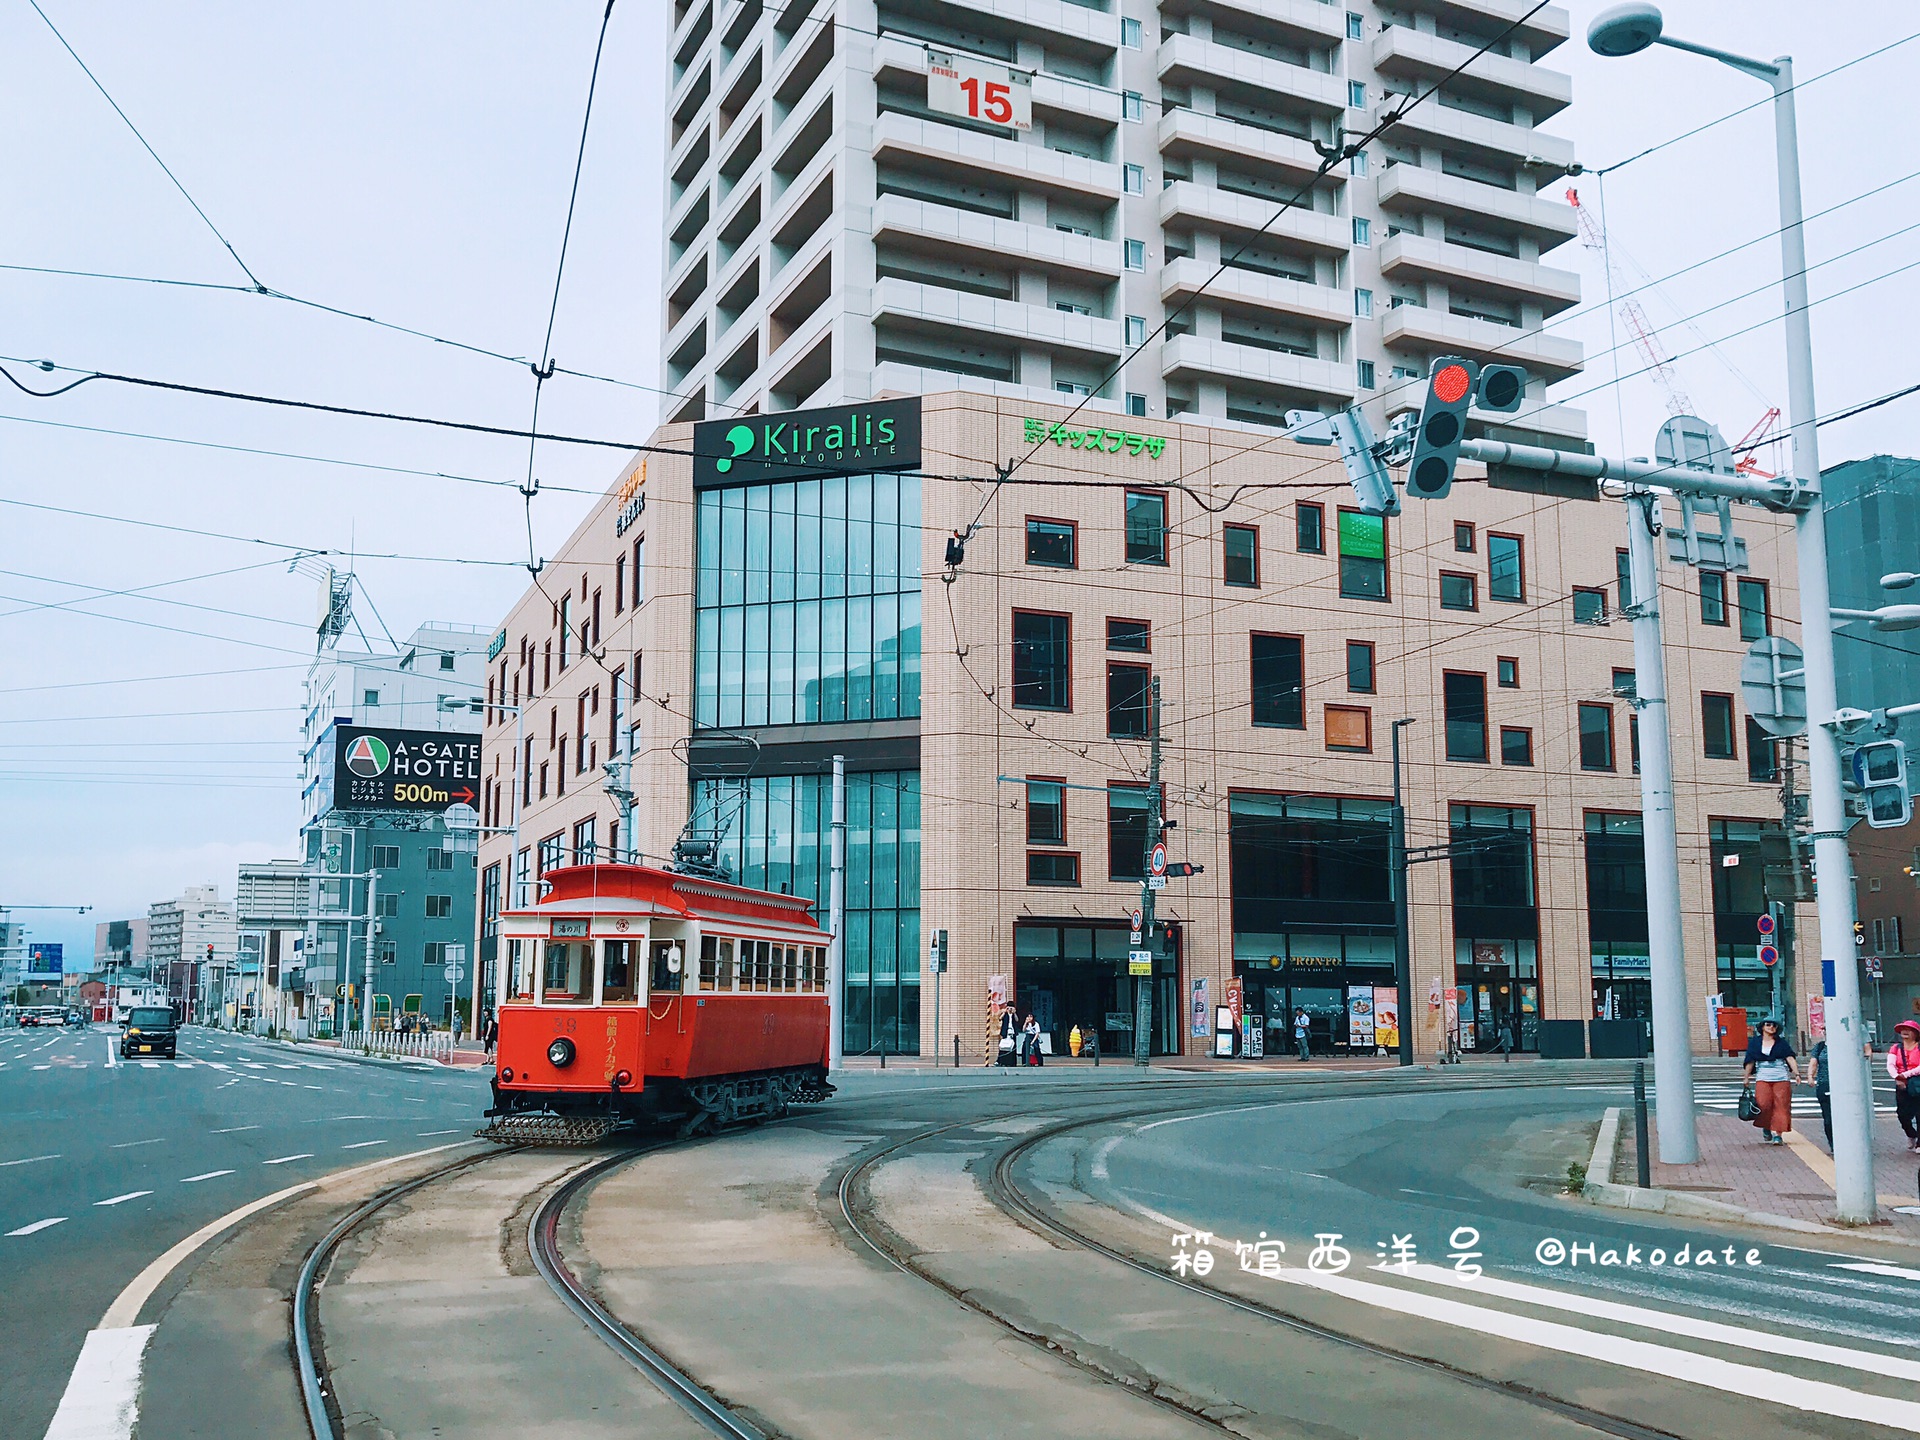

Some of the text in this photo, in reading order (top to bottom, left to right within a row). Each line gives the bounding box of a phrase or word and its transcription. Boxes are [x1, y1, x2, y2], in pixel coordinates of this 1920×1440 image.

[960, 77, 1013, 123] 15
[764, 414, 896, 456] Kiralis
[1049, 422, 1166, 459] キッズプラザ
[394, 740, 479, 759] A-GATE
[393, 757, 479, 779] HOTEL
[351, 780, 385, 788] カプセル
[351, 787, 384, 795] ビジネス
[393, 783, 448, 803] 500m
[351, 794, 384, 802] レンタカー
[327, 843, 341, 874] すし
[1153, 852, 1164, 867] 40
[559, 924, 581, 934] 湯の川
[1613, 957, 1648, 967] FamilyMart
[553, 1016, 577, 1034] 39
